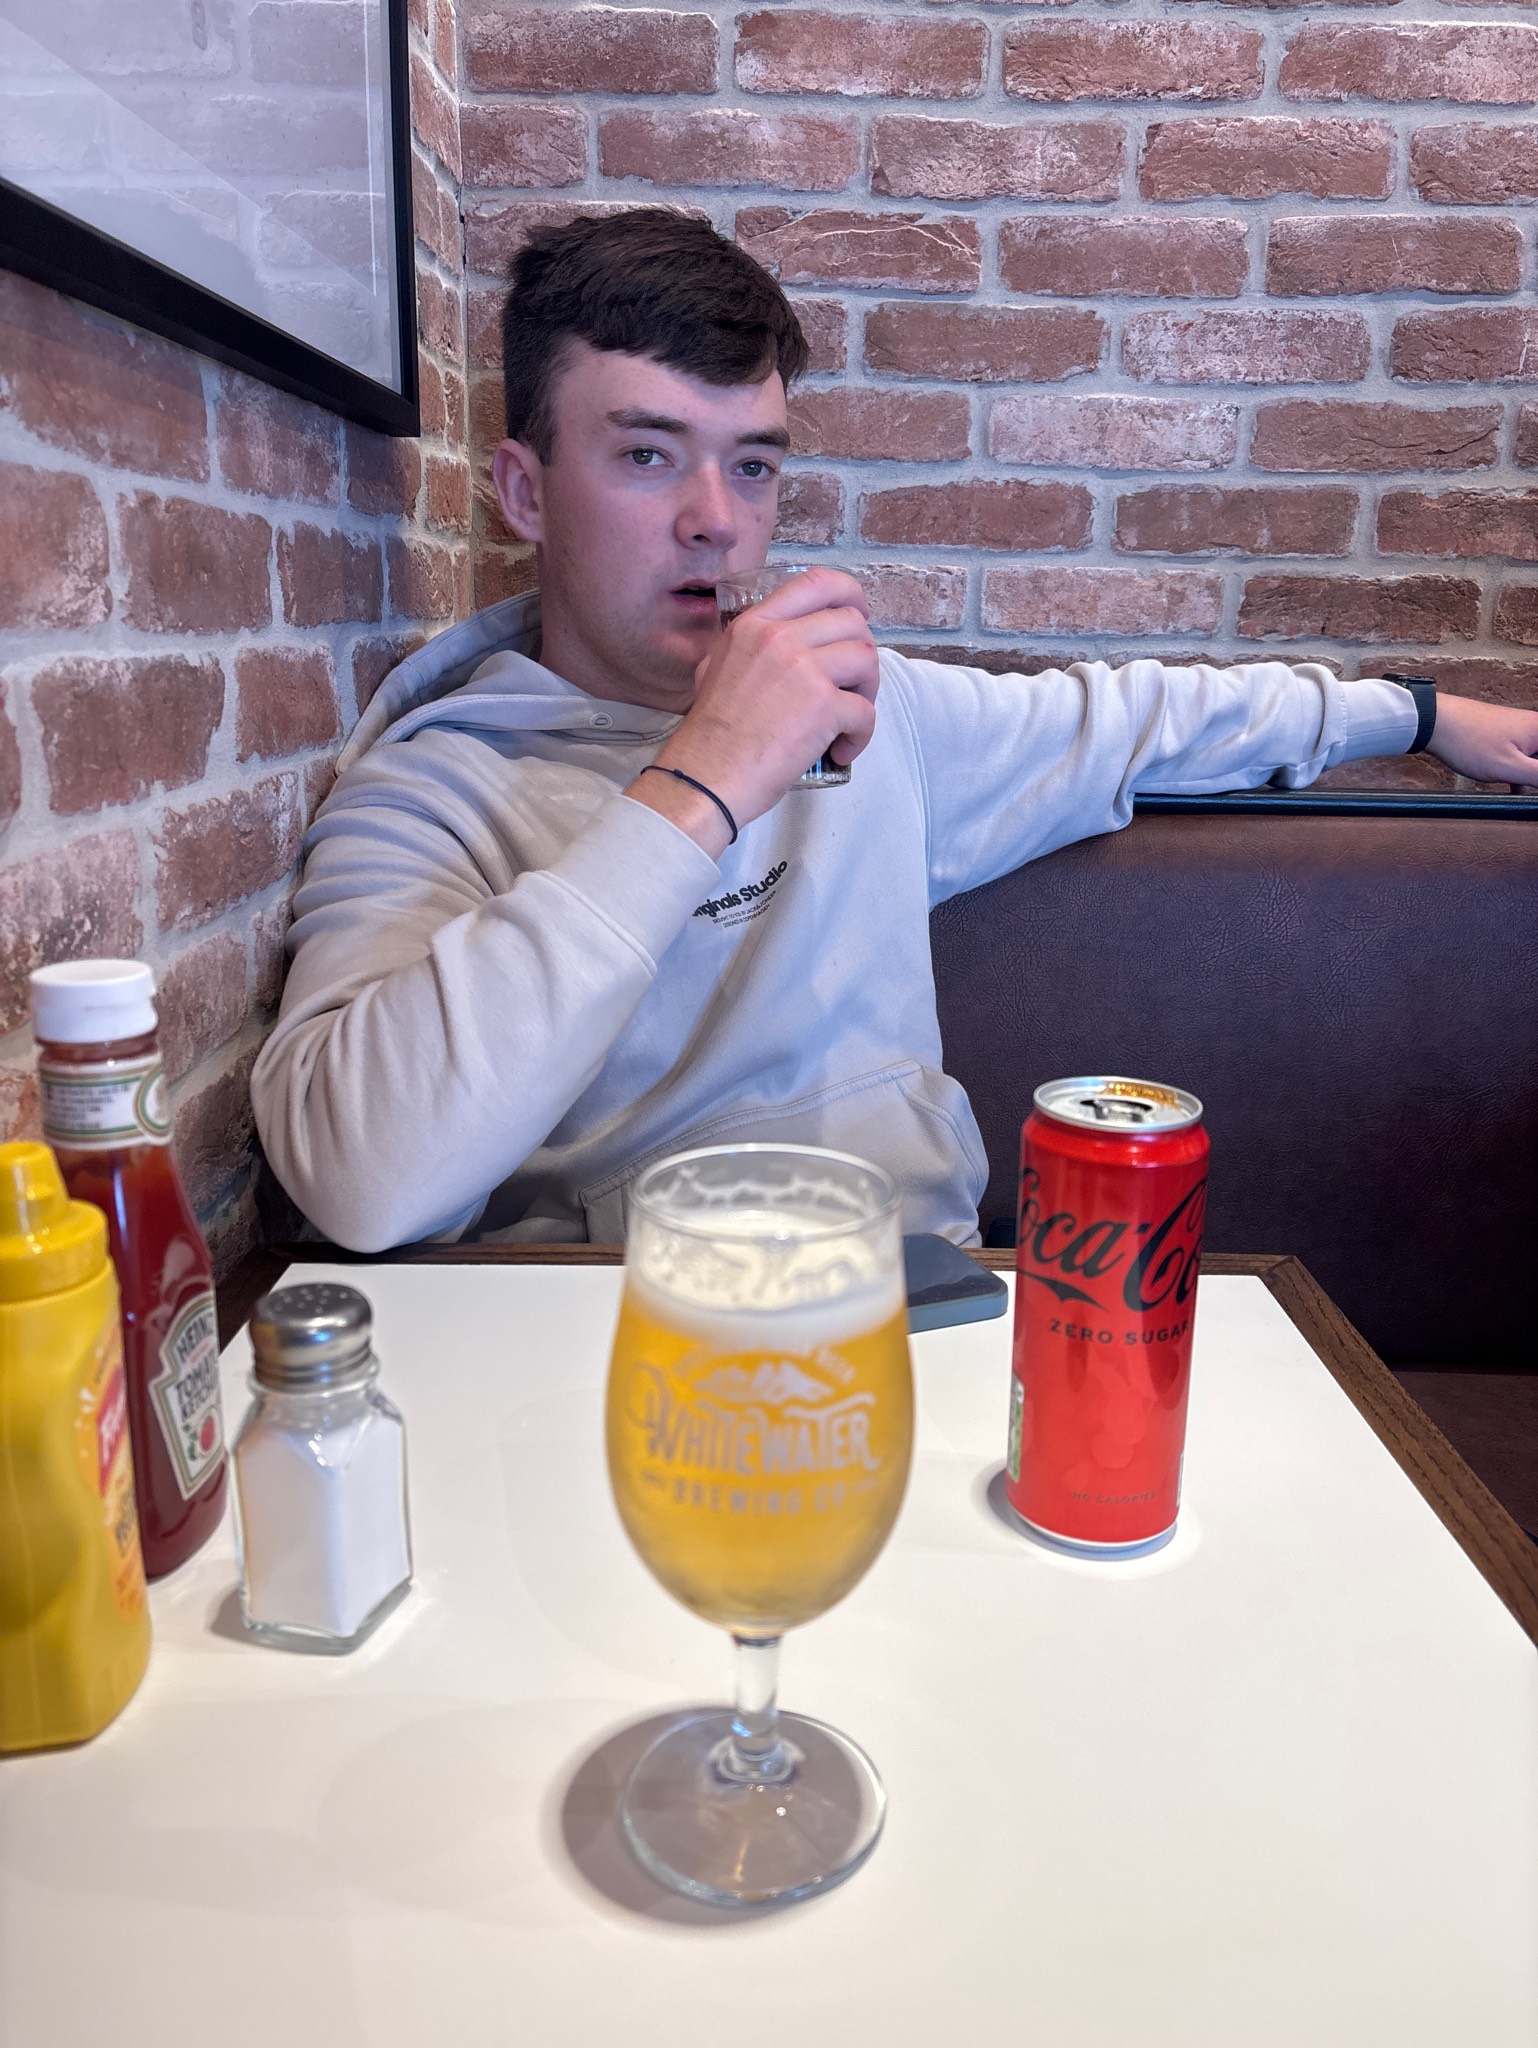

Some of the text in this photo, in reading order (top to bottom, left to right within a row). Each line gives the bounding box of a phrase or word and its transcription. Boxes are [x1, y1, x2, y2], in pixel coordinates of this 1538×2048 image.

[692, 860, 788, 918] riginals Studio
[1051, 1318, 1113, 1345] ZERO
[1073, 1490, 1158, 1505] NO CALORIES
